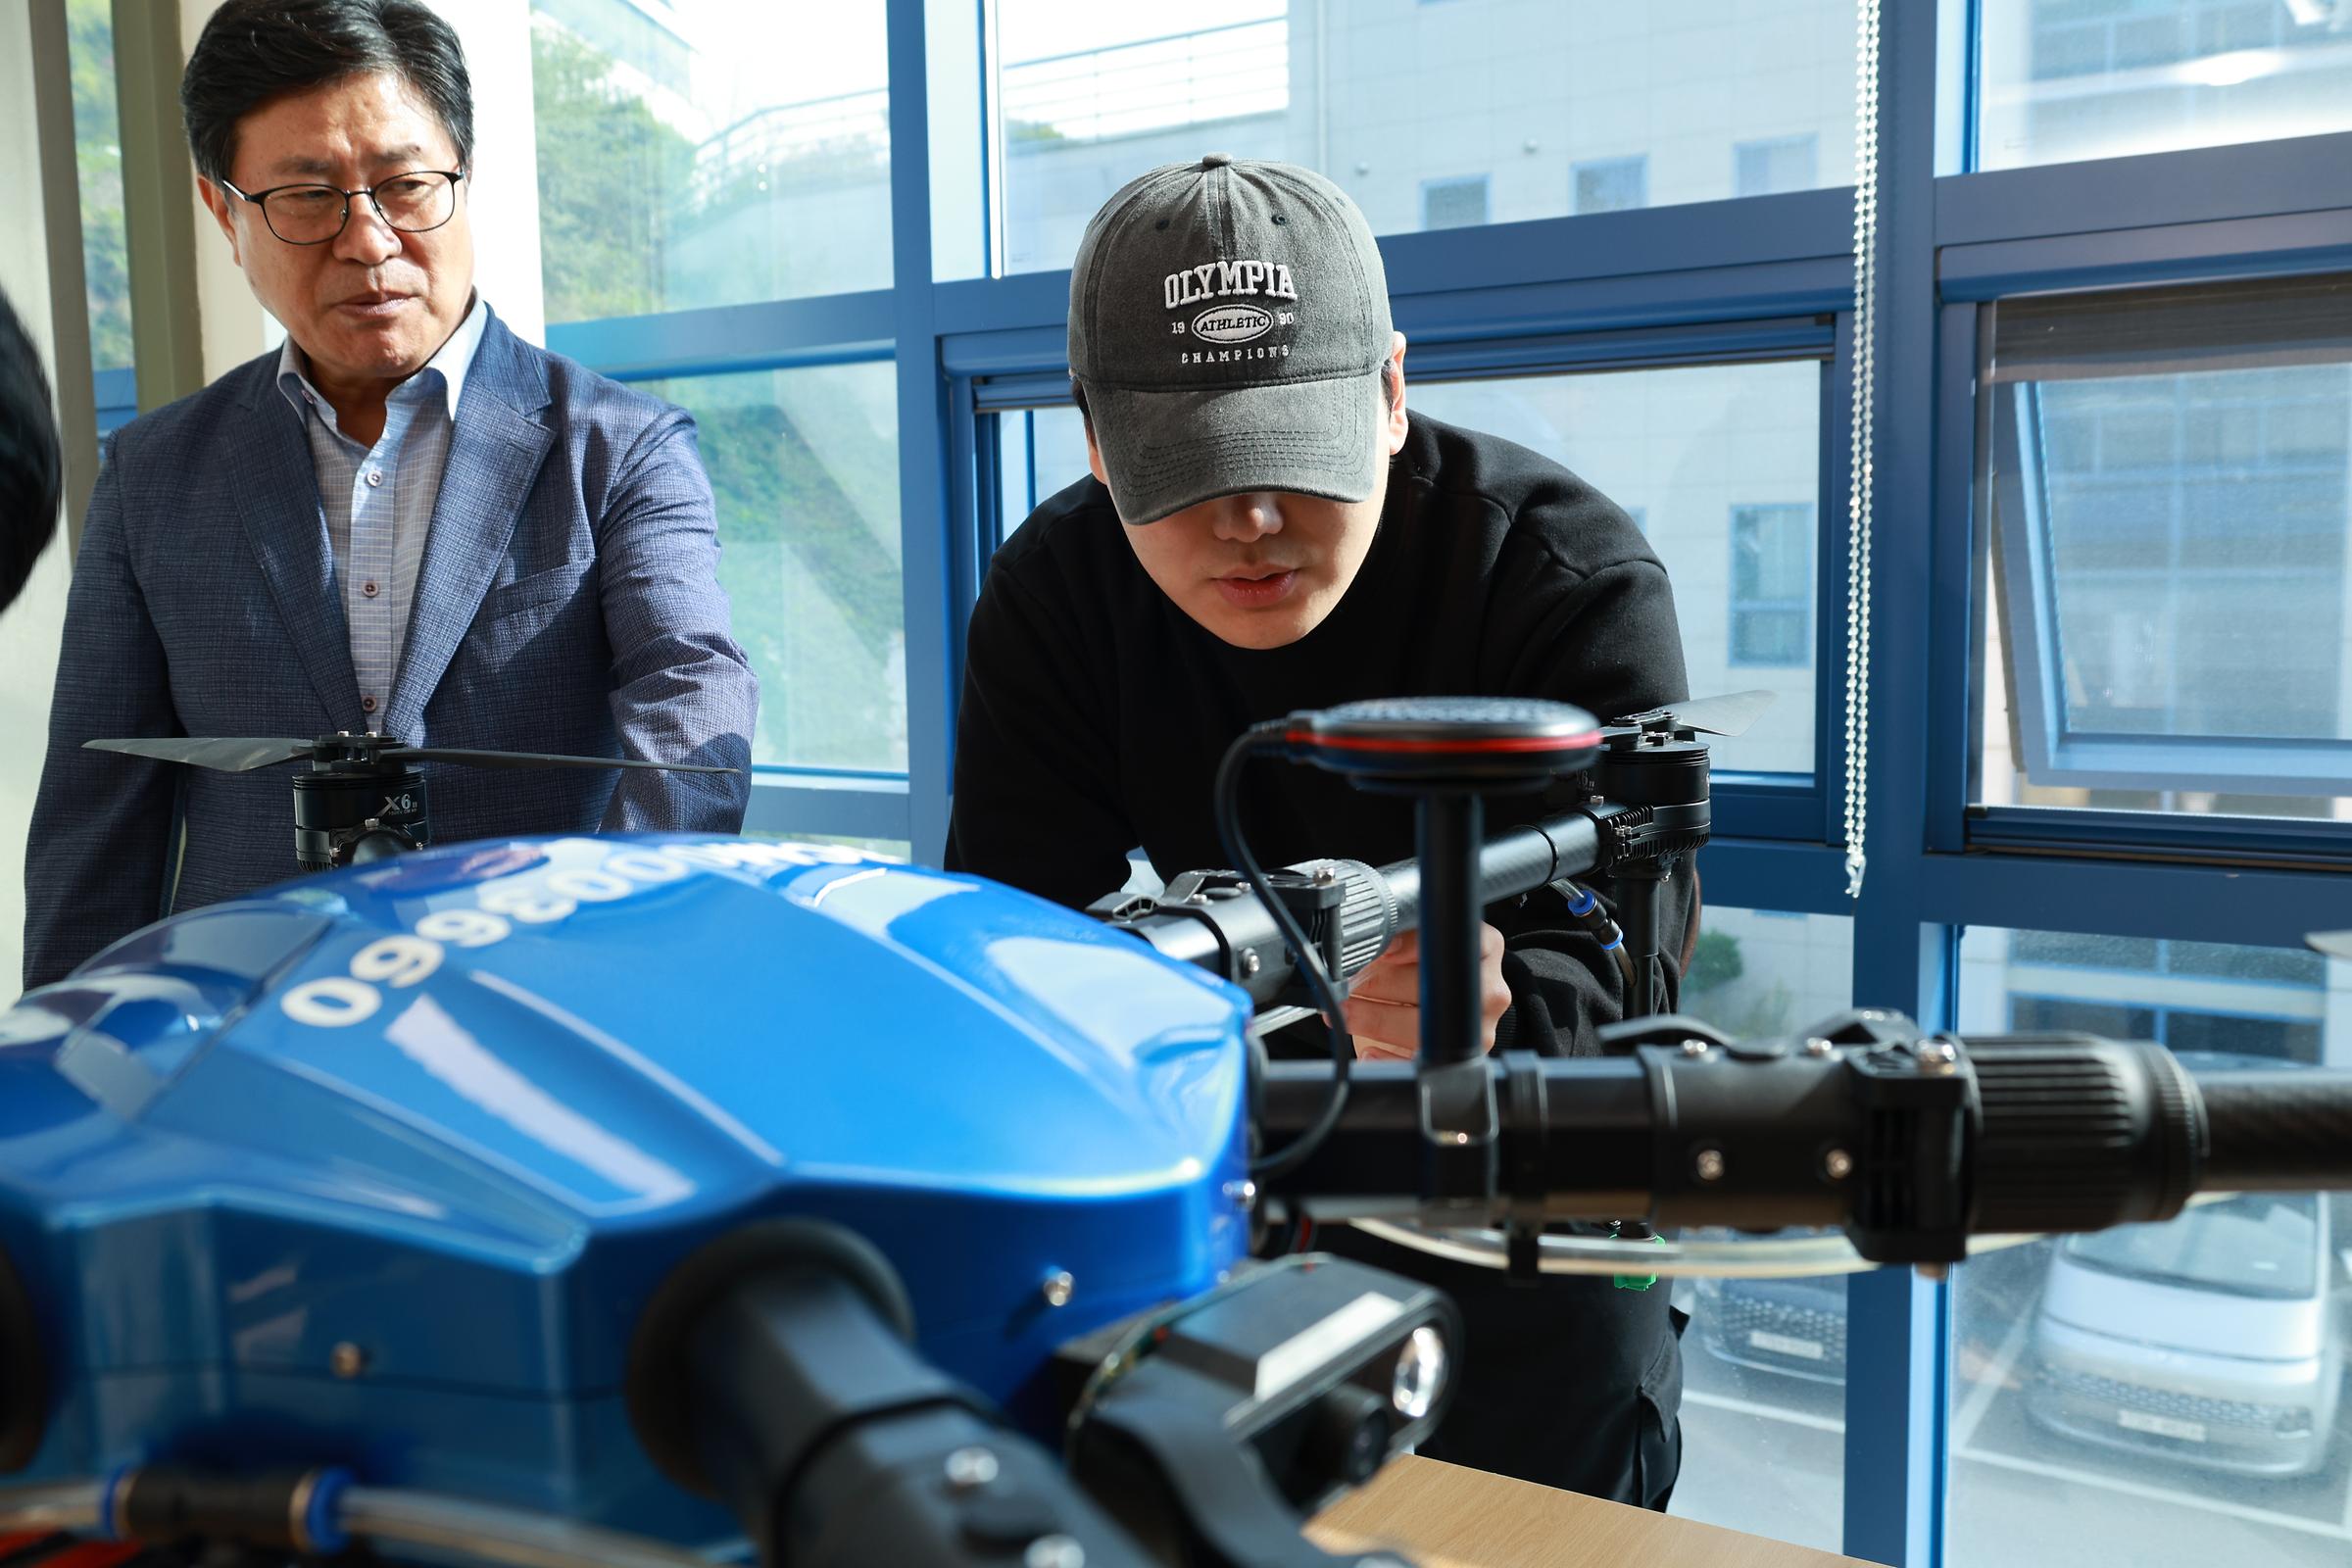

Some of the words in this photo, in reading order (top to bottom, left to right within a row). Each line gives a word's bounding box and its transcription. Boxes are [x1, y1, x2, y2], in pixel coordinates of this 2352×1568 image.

[1164, 261, 1298, 309] OLYMPIA
[1171, 321, 1185, 334] 19
[1200, 317, 1266, 332] ATHLETIC
[1280, 313, 1295, 325] 90
[1182, 345, 1290, 364] CHAMPIONS
[376, 794, 412, 816] X6
